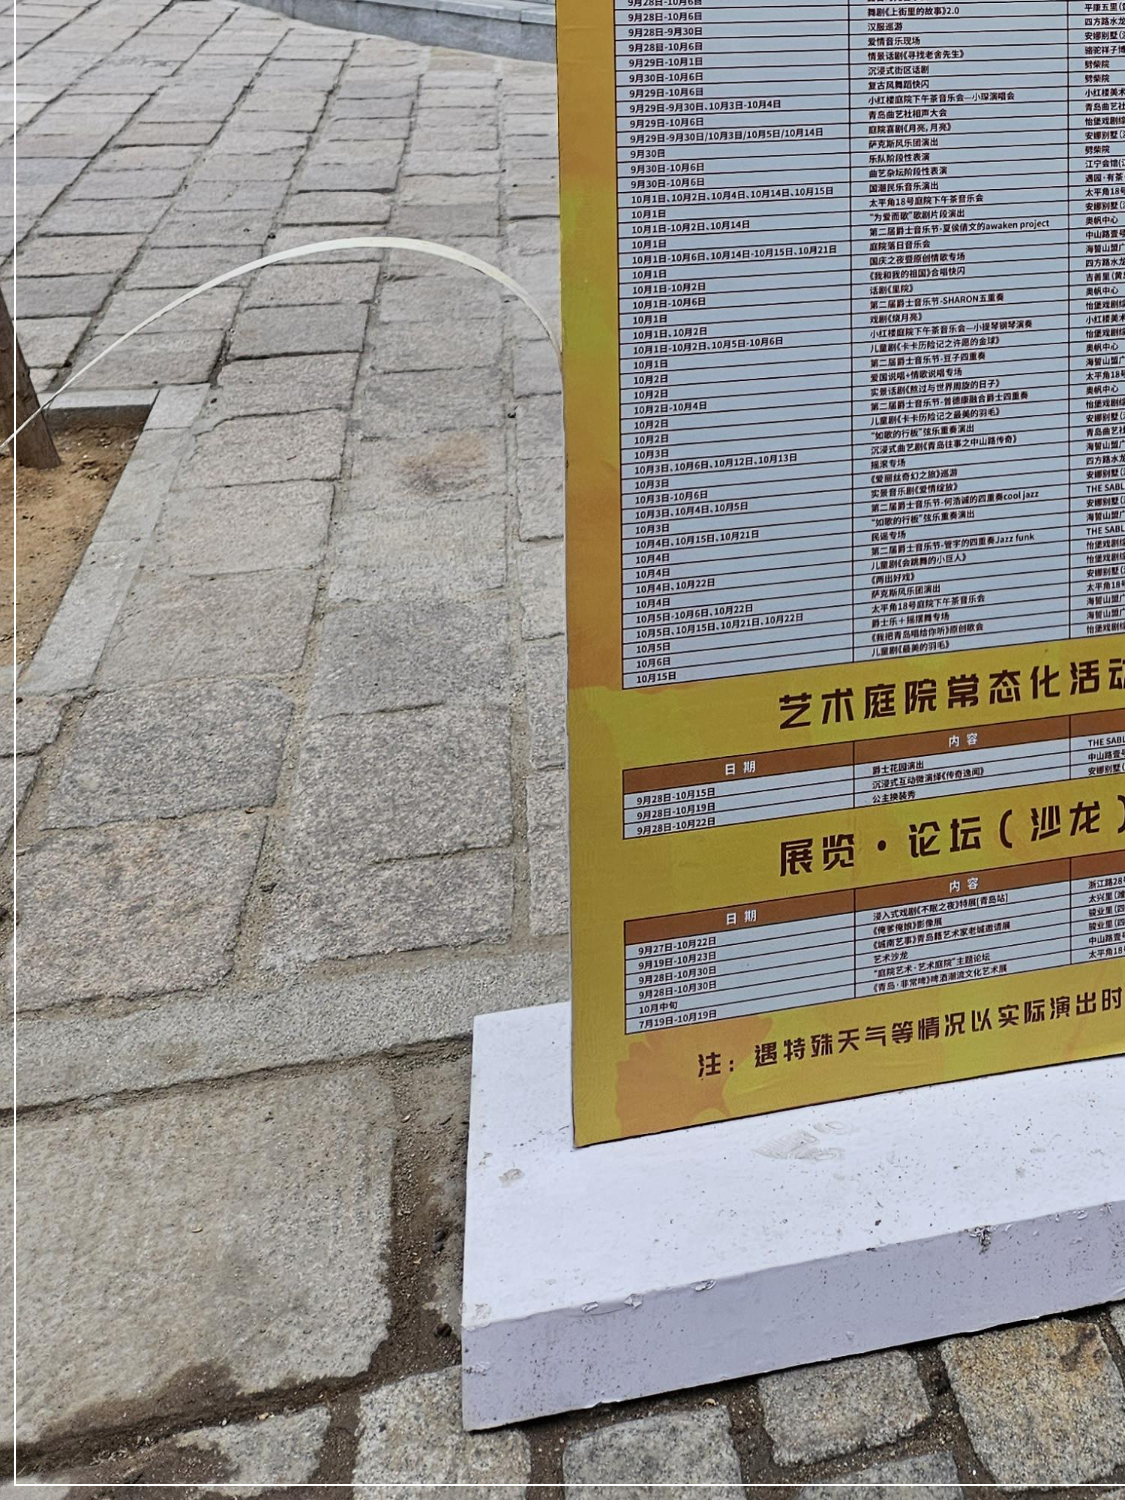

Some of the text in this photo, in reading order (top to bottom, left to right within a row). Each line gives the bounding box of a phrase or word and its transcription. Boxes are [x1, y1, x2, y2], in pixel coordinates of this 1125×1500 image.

[628, 12, 701, 22] 9月28日-10月6日
[628, 27, 702, 37] 9月28日-9月30日
[868, 22, 902, 31] 汉服巡游
[628, 42, 702, 52] 9月28日-10月6日
[629, 57, 702, 67] 9月29日-10月1日
[629, 72, 702, 83] 9月30日-10月6日
[629, 87, 703, 98] 9月29日-10月6日
[630, 117, 703, 128] 9月29日-10月6日
[630, 149, 664, 158] 9月30日
[631, 162, 703, 174] 9月30日-10月6日
[631, 178, 704, 189] 9月30日-10月6日
[632, 209, 665, 218] 10月1日
[1086, 216, 1118, 225] 奥帆中心
[632, 239, 666, 249] 10月1日
[633, 269, 666, 279] 10月1日
[633, 282, 705, 294] 10月1日-10月2日
[633, 297, 705, 309] 10月1日-10月6日
[633, 314, 667, 324] 10月1日
[633, 327, 707, 339] 10月1日、10月2日
[634, 359, 667, 369] 10月1日
[634, 374, 667, 384] 10月2日
[634, 389, 667, 399] 10月2日
[634, 401, 706, 414] 10月2日-10月4日
[635, 419, 668, 429] 10月2日
[635, 434, 668, 444] 10月2日
[635, 449, 668, 459] 10月3日
[635, 478, 668, 489] 10月3日
[635, 490, 707, 504] 10月3日-10月6日
[636, 523, 669, 534] 10月3日
[871, 530, 905, 541] 民谣专场
[636, 553, 669, 564] 10月4日
[636, 568, 669, 579] 10月4日
[636, 578, 714, 593] 10月4日、10月22日
[636, 598, 670, 608] 10月4日
[637, 642, 670, 653] 10月5日
[637, 657, 670, 668] 10月6日
[637, 671, 676, 683] 10月15日
[1088, 738, 1104, 747] THE
[637, 787, 715, 805] 9月28日-10月15日
[873, 790, 915, 803] 公主换装秀
[637, 802, 715, 820] 9月28日-10月19日
[637, 817, 715, 835] 9月28日-10月22日
[638, 936, 715, 955] 9月27日-10月22日
[638, 951, 715, 970] 9月19日-10月23日
[873, 951, 908, 963] 艺术沙龙
[639, 966, 715, 984] 9月28日-10月30日
[639, 980, 716, 999] 9月28日-10月30日
[639, 1001, 677, 1014] 10月中旬
[639, 1009, 716, 1028] 7月19日-10月19日
